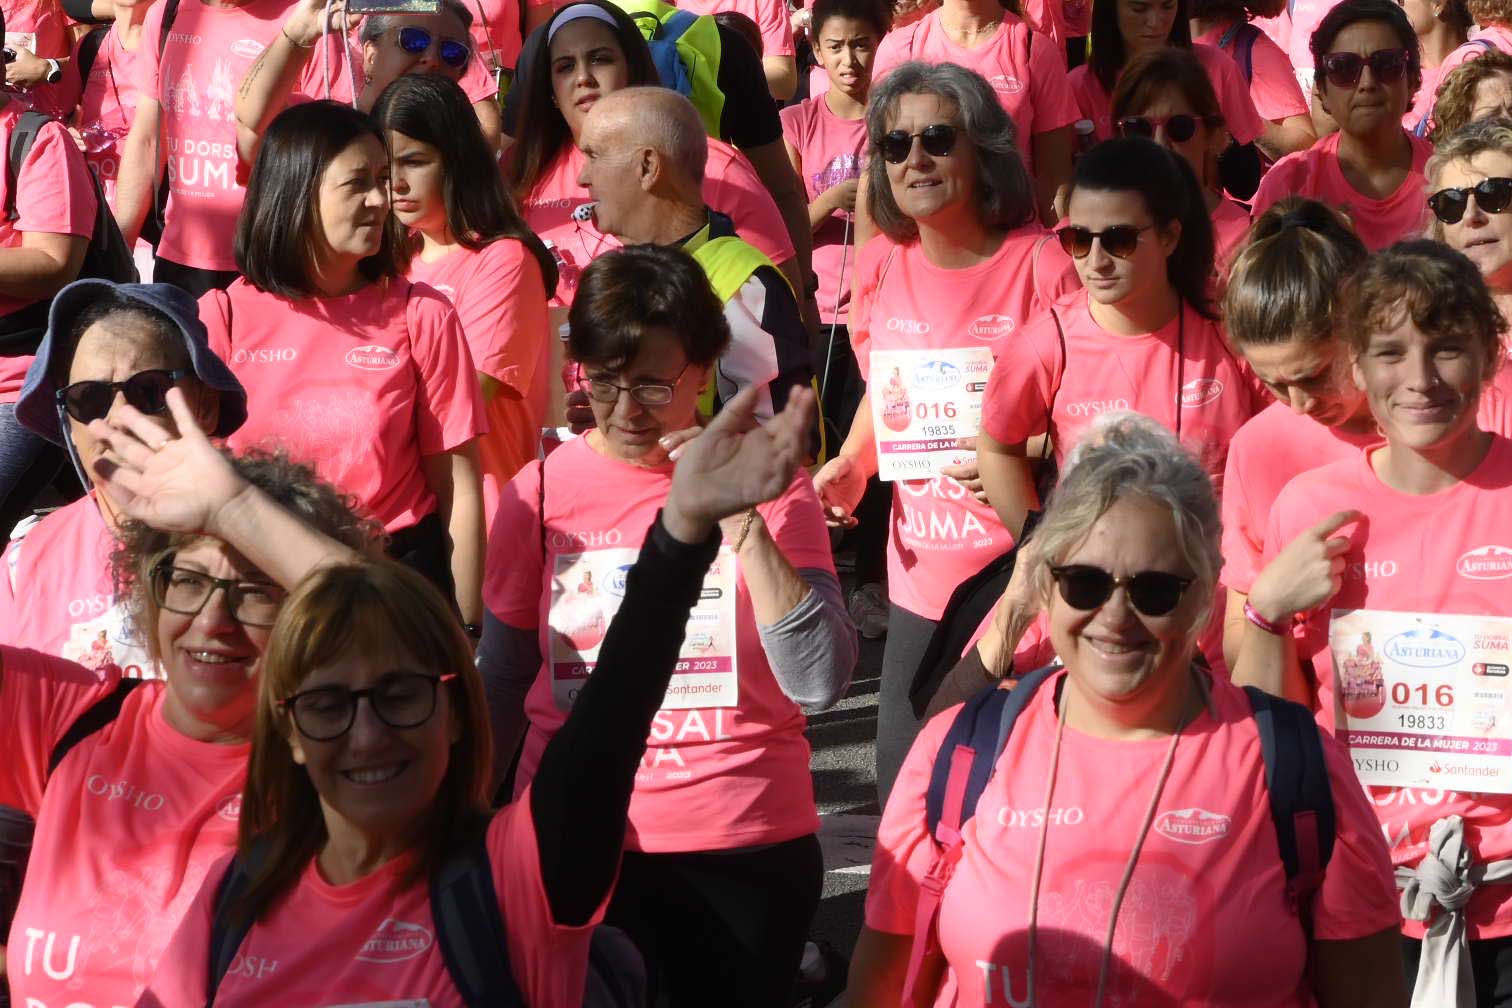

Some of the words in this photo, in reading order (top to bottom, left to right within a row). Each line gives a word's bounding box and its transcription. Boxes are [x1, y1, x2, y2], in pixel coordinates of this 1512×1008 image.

[234, 347, 297, 365] OYSHO
[350, 353, 399, 368] ASTURIANA
[915, 401, 957, 419] 016
[1066, 398, 1129, 417] OYSHO
[921, 424, 956, 437] 19835
[892, 443, 926, 451] CARRERA
[898, 504, 987, 541] SUMA
[551, 528, 623, 548] OYSHO
[1390, 640, 1459, 660] ASTURIANA
[1472, 641, 1509, 651] SUMA
[693, 660, 719, 671] 2023
[1391, 682, 1455, 707] 016
[1397, 714, 1446, 730] 19833
[1348, 735, 1400, 745] CARRERA
[1401, 738, 1416, 747] DE
[1417, 739, 1432, 748] LA
[1433, 740, 1470, 751] MUJER
[1442, 762, 1500, 777] Santander
[996, 805, 1084, 827] OYSHO
[1159, 817, 1229, 838] ASTURIANA
[24, 926, 82, 980] TU
[975, 959, 1034, 1008] TU
